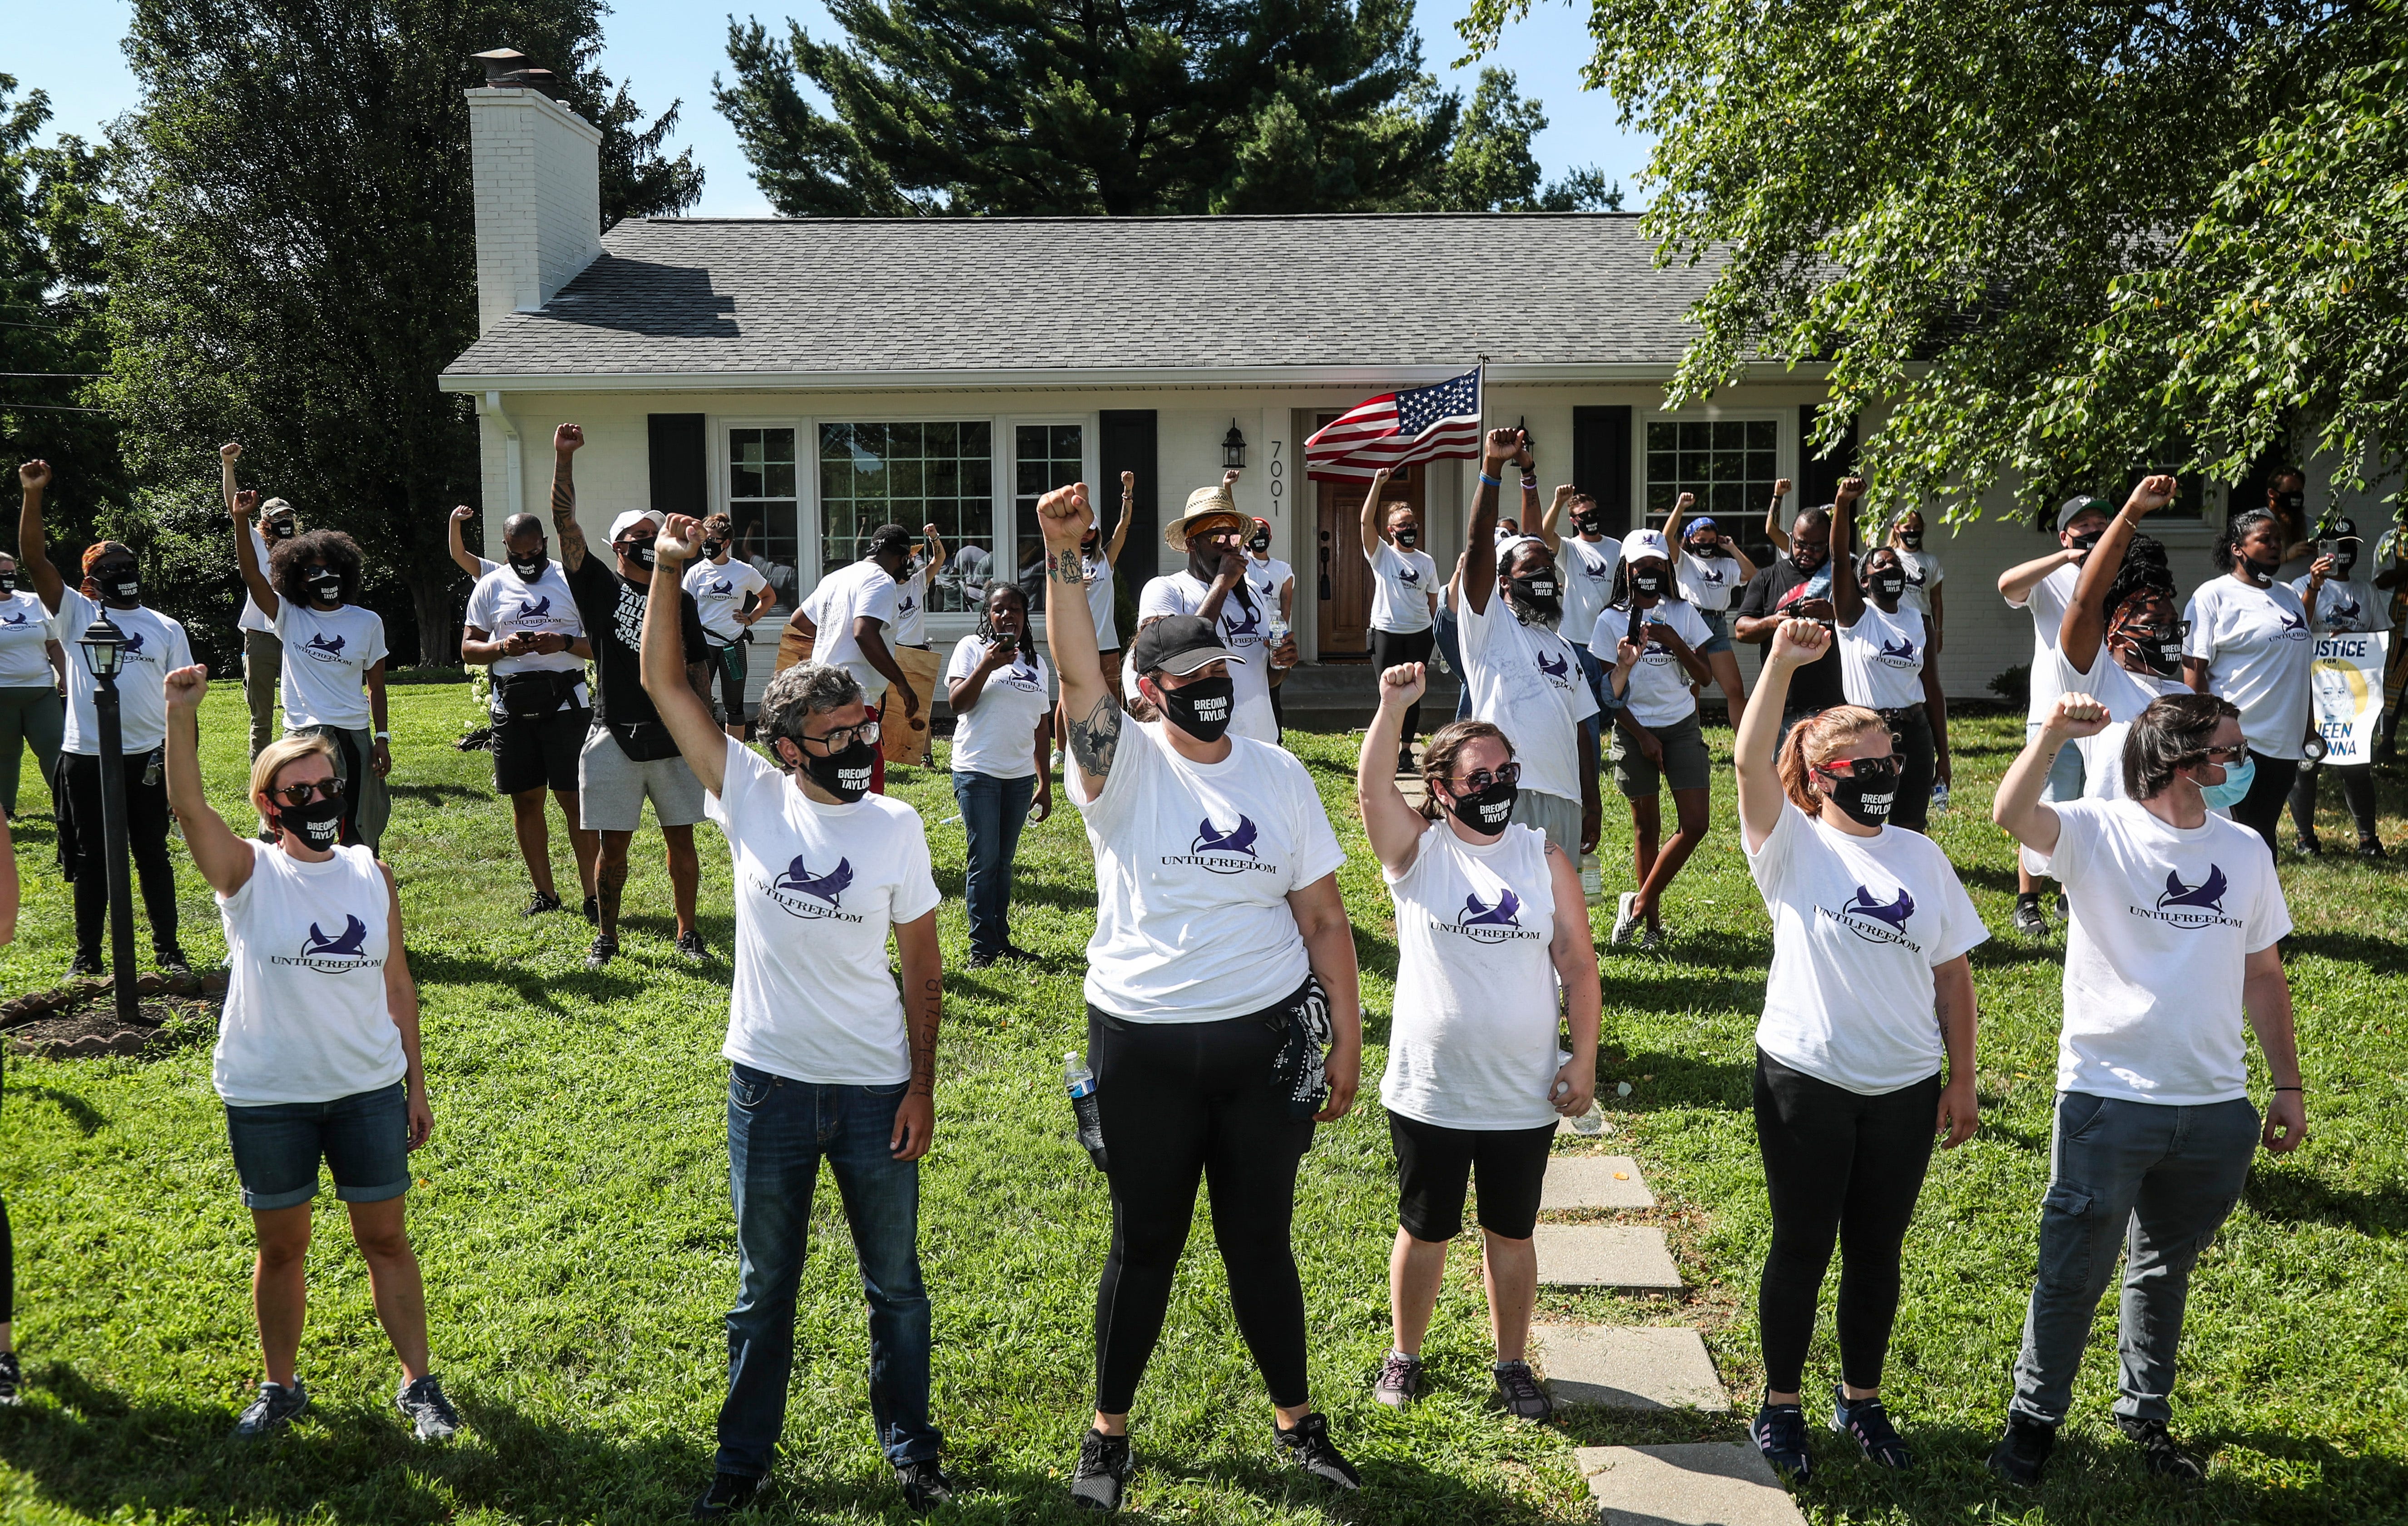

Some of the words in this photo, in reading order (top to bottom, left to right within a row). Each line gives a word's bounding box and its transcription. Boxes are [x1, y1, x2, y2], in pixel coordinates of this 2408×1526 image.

[1271, 441, 1283, 517] 7001
[504, 618, 562, 626] UNTILFREEDOM
[613, 610, 635, 627] ARE
[1194, 696, 1227, 710] BREONNA
[1199, 708, 1227, 721] TAYLOR
[837, 765, 872, 779] BREONNA
[842, 777, 870, 790] TAYLOR
[1860, 791, 1894, 804] BREONNA
[1480, 798, 1511, 815] BREONNA
[1863, 803, 1891, 815] TAYLOR
[1483, 809, 1508, 823] TAYLOR
[307, 816, 338, 831] BREONNA
[311, 826, 337, 840] TAYLOR
[1161, 855, 1277, 875] UNTILFREEDOM
[748, 873, 864, 924] UNTILFREEDOM
[2129, 906, 2243, 929] UNTILFREEDOM
[1430, 921, 1541, 940] UNTILFREEDOM
[1813, 904, 1922, 954] UNTILFREEDOM
[271, 955, 382, 969] UNTILFREEDOM
